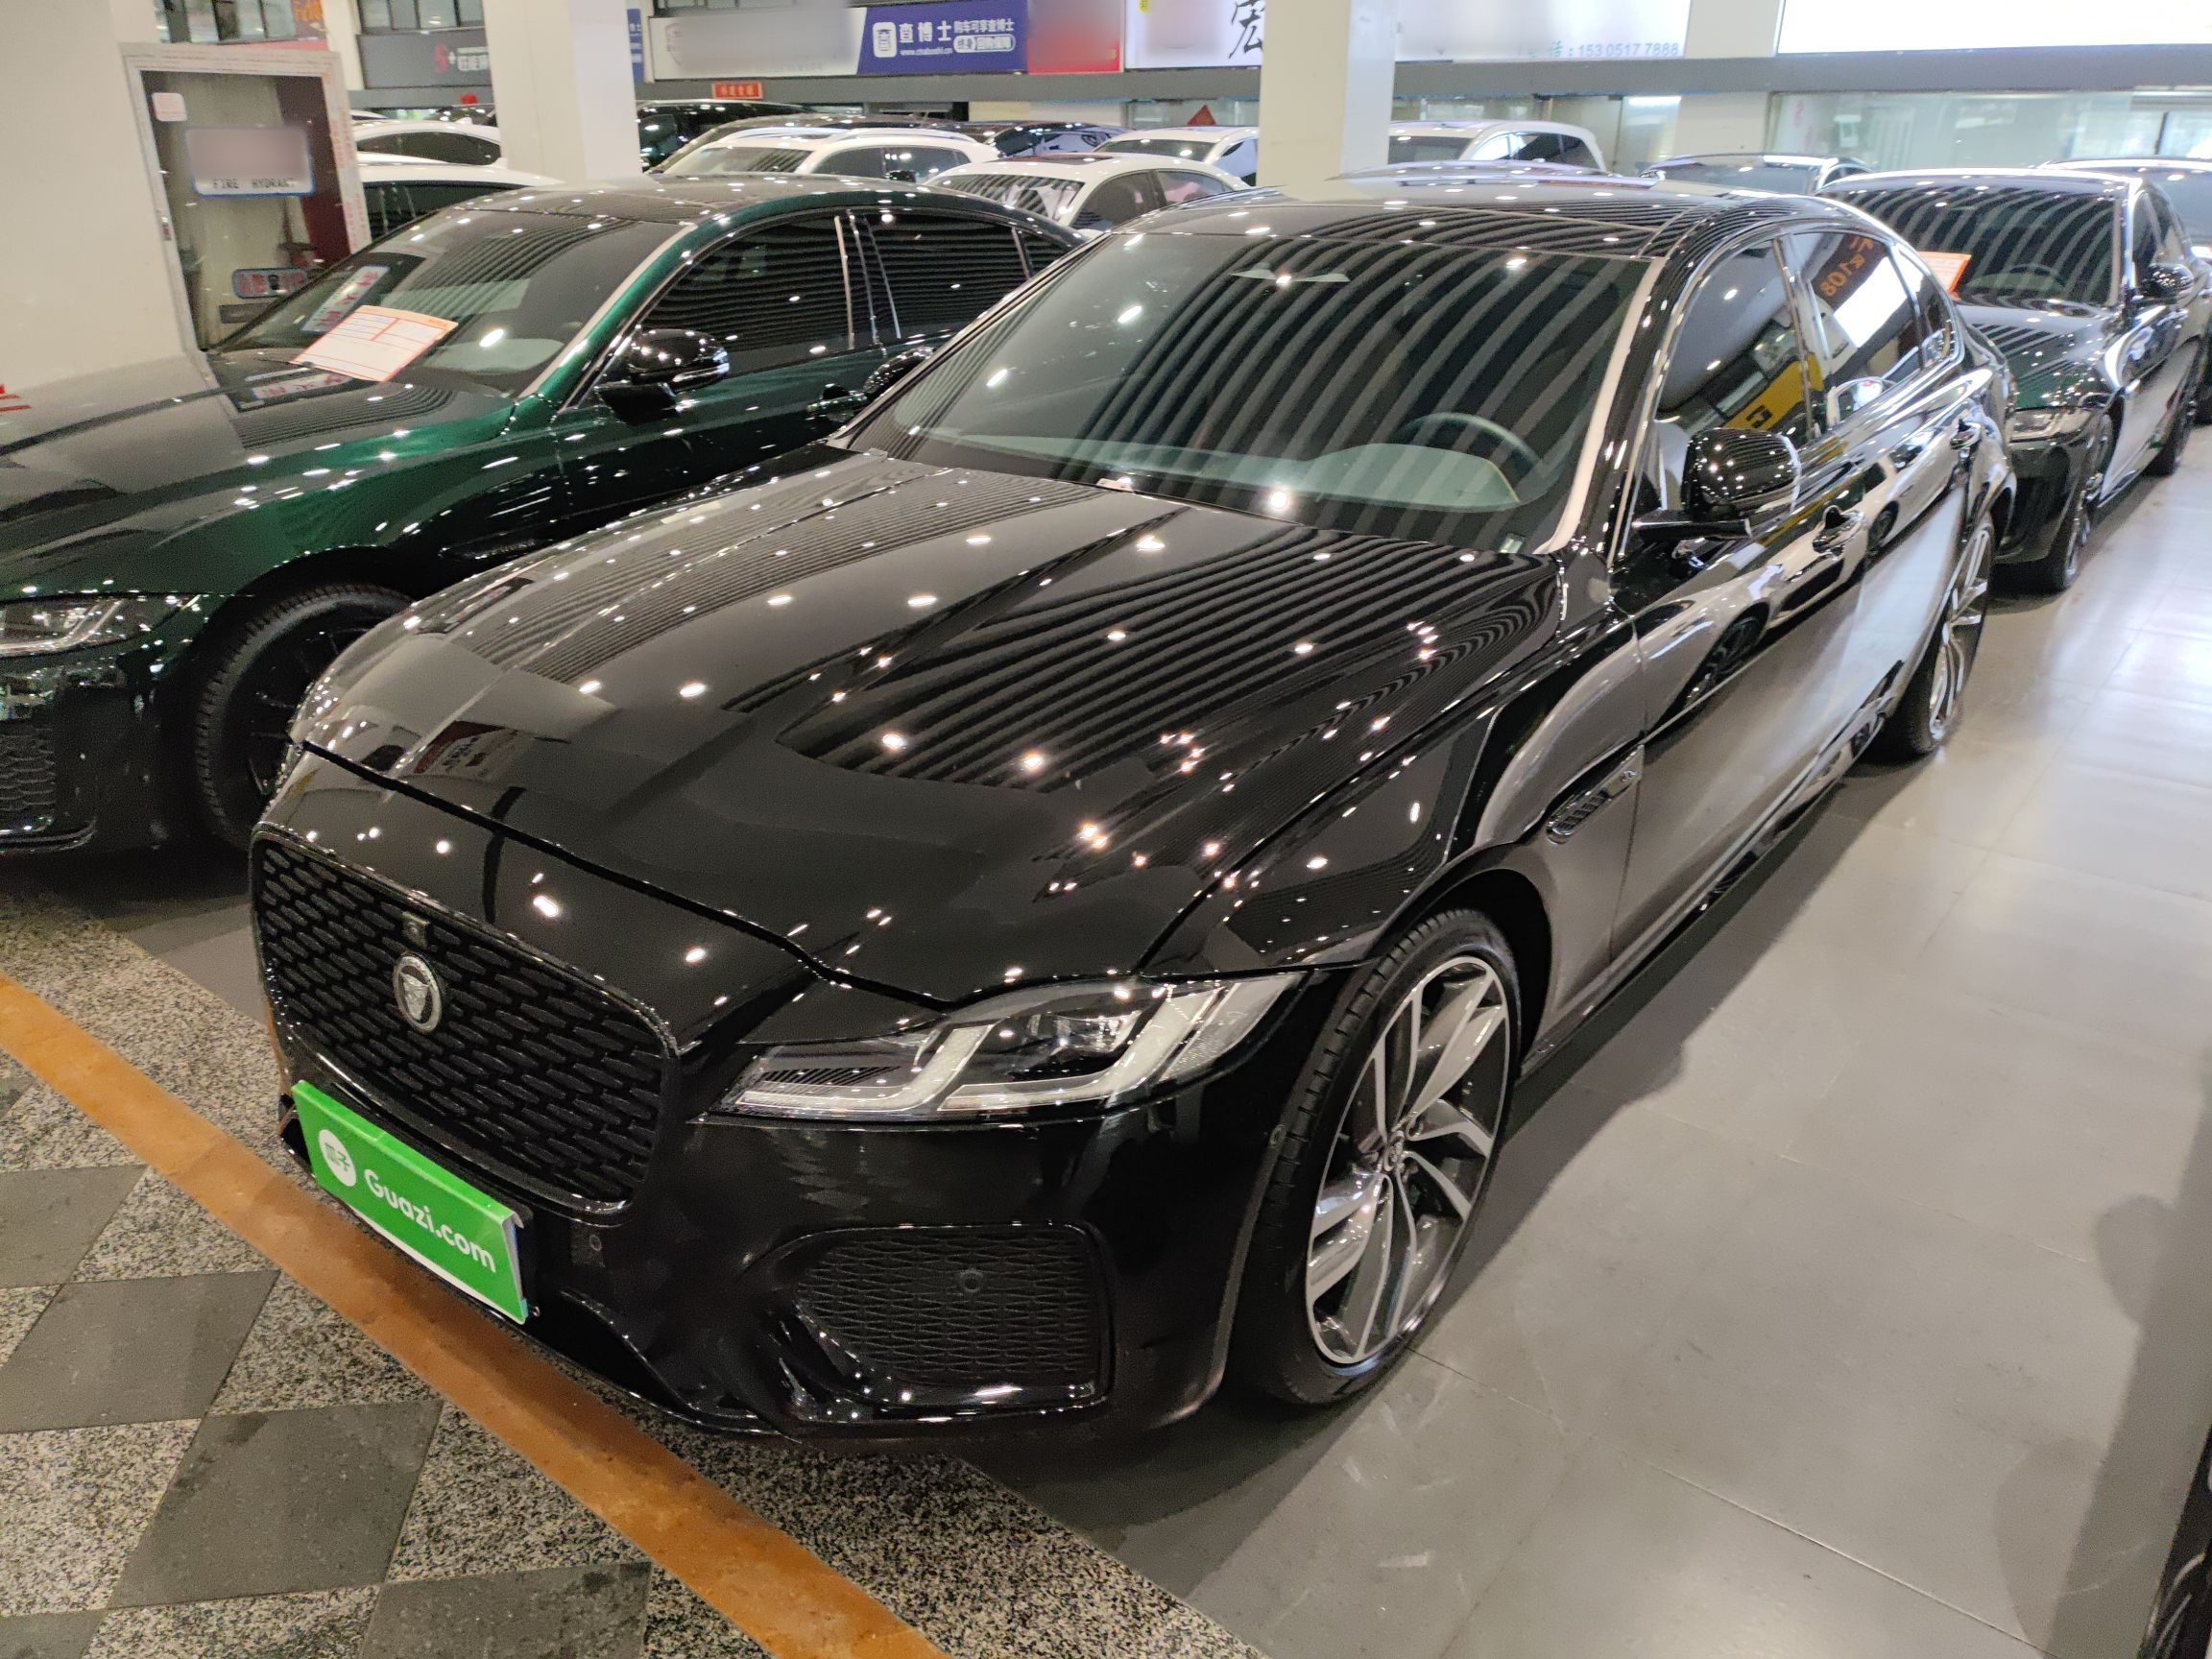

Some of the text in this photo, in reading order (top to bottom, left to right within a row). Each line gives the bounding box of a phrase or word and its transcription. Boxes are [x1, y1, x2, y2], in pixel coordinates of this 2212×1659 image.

[899, 20, 952, 43] 查博士
[213, 178, 240, 189] FIRE
[364, 1168, 496, 1274] Guazi.com
